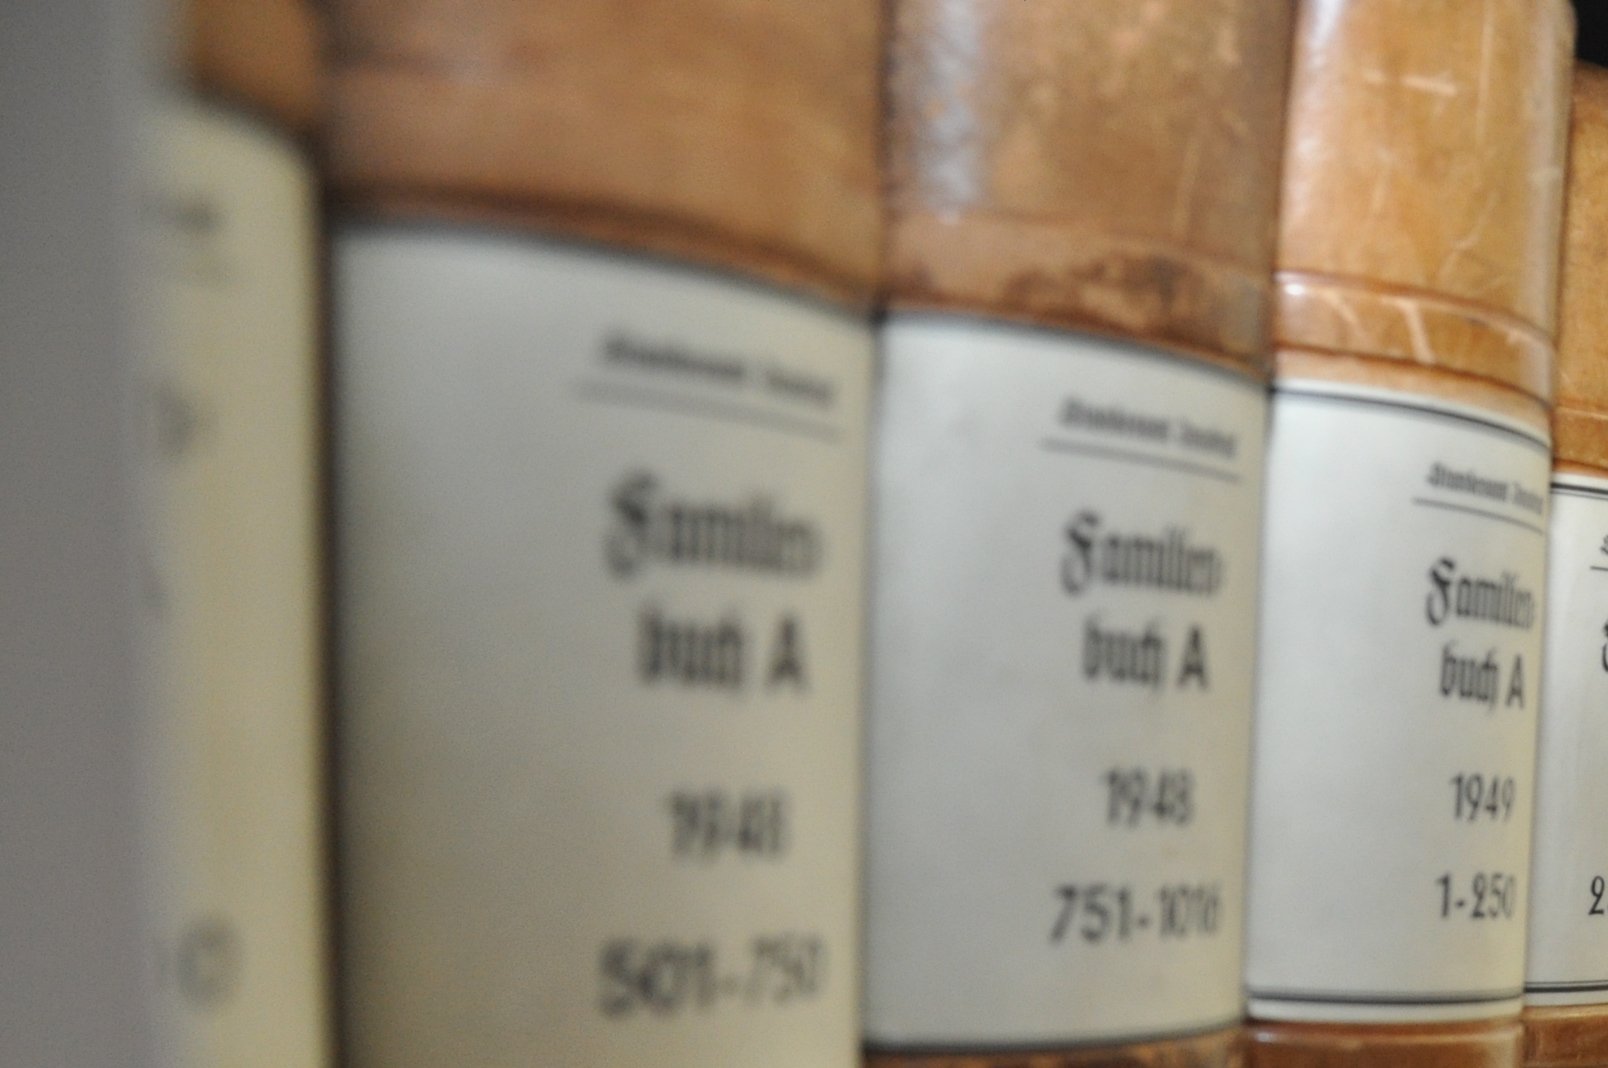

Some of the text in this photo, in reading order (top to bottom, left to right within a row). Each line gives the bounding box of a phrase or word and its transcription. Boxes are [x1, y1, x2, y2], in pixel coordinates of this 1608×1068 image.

[764, 609, 812, 692] A
[1175, 622, 1210, 691] A
[1505, 653, 1525, 709] A
[1449, 772, 1516, 822] 1949
[1435, 870, 1516, 920] 1-250
